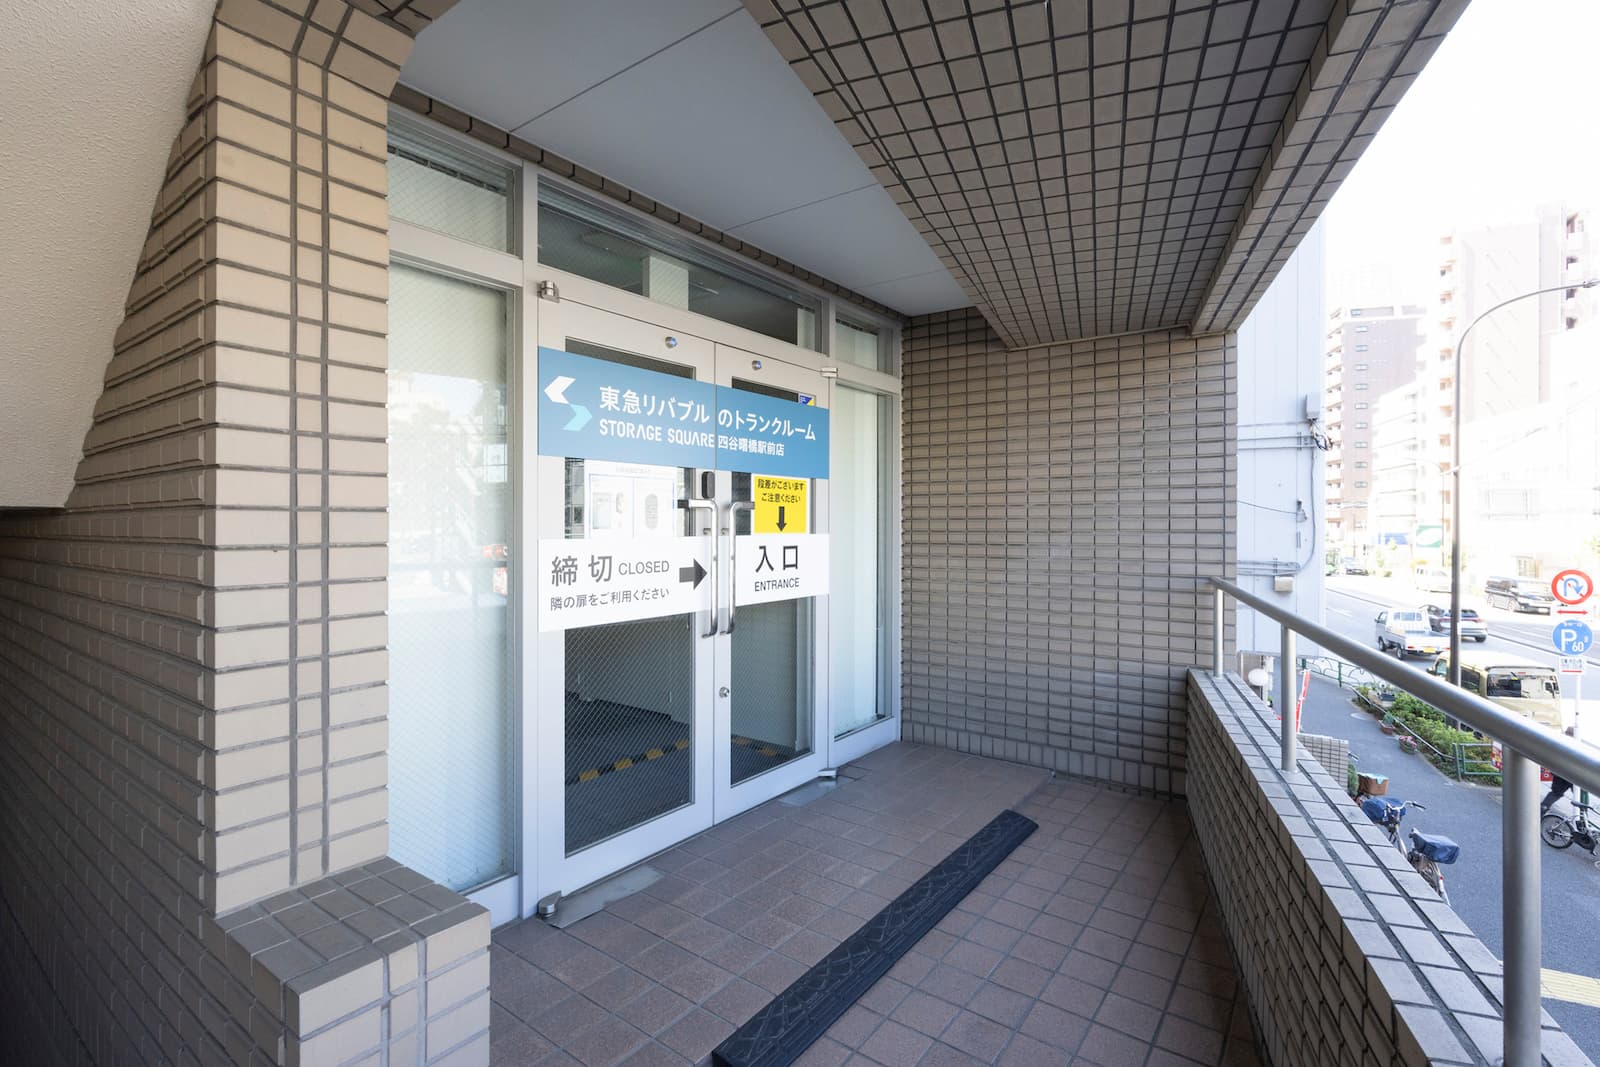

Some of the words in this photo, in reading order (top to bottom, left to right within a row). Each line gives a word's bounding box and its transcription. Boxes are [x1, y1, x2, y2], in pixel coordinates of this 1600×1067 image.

[599, 418, 662, 442] STORAGE
[667, 428, 715, 448] SQUARE
[761, 492, 800, 503] ご注意ください
[551, 555, 612, 587] 締切
[618, 560, 670, 575] CLOSED
[755, 545, 798, 573] 入口
[754, 577, 800, 592] ENTRANCE
[550, 588, 670, 611] 隣の扉をご利用ください
[1560, 628, 1577, 652] P
